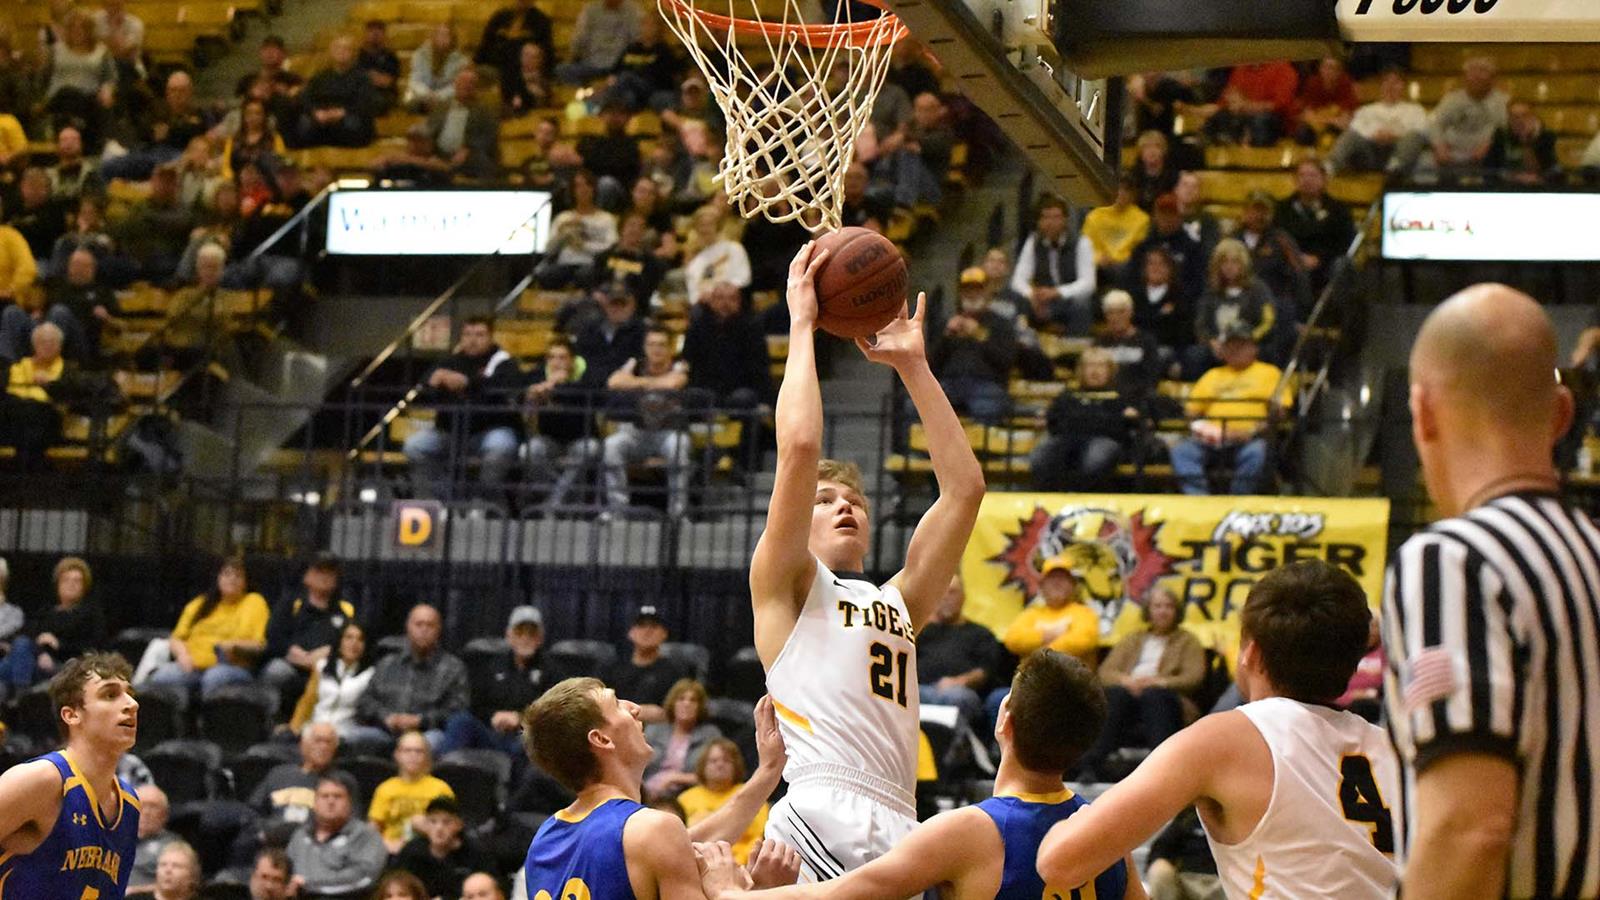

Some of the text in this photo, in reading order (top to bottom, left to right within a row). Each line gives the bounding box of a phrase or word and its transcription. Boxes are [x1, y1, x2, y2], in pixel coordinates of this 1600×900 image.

[399, 507, 433, 545] D
[1180, 540, 1367, 577] TIGER
[867, 640, 909, 709] 21
[1336, 751, 1395, 858] 4
